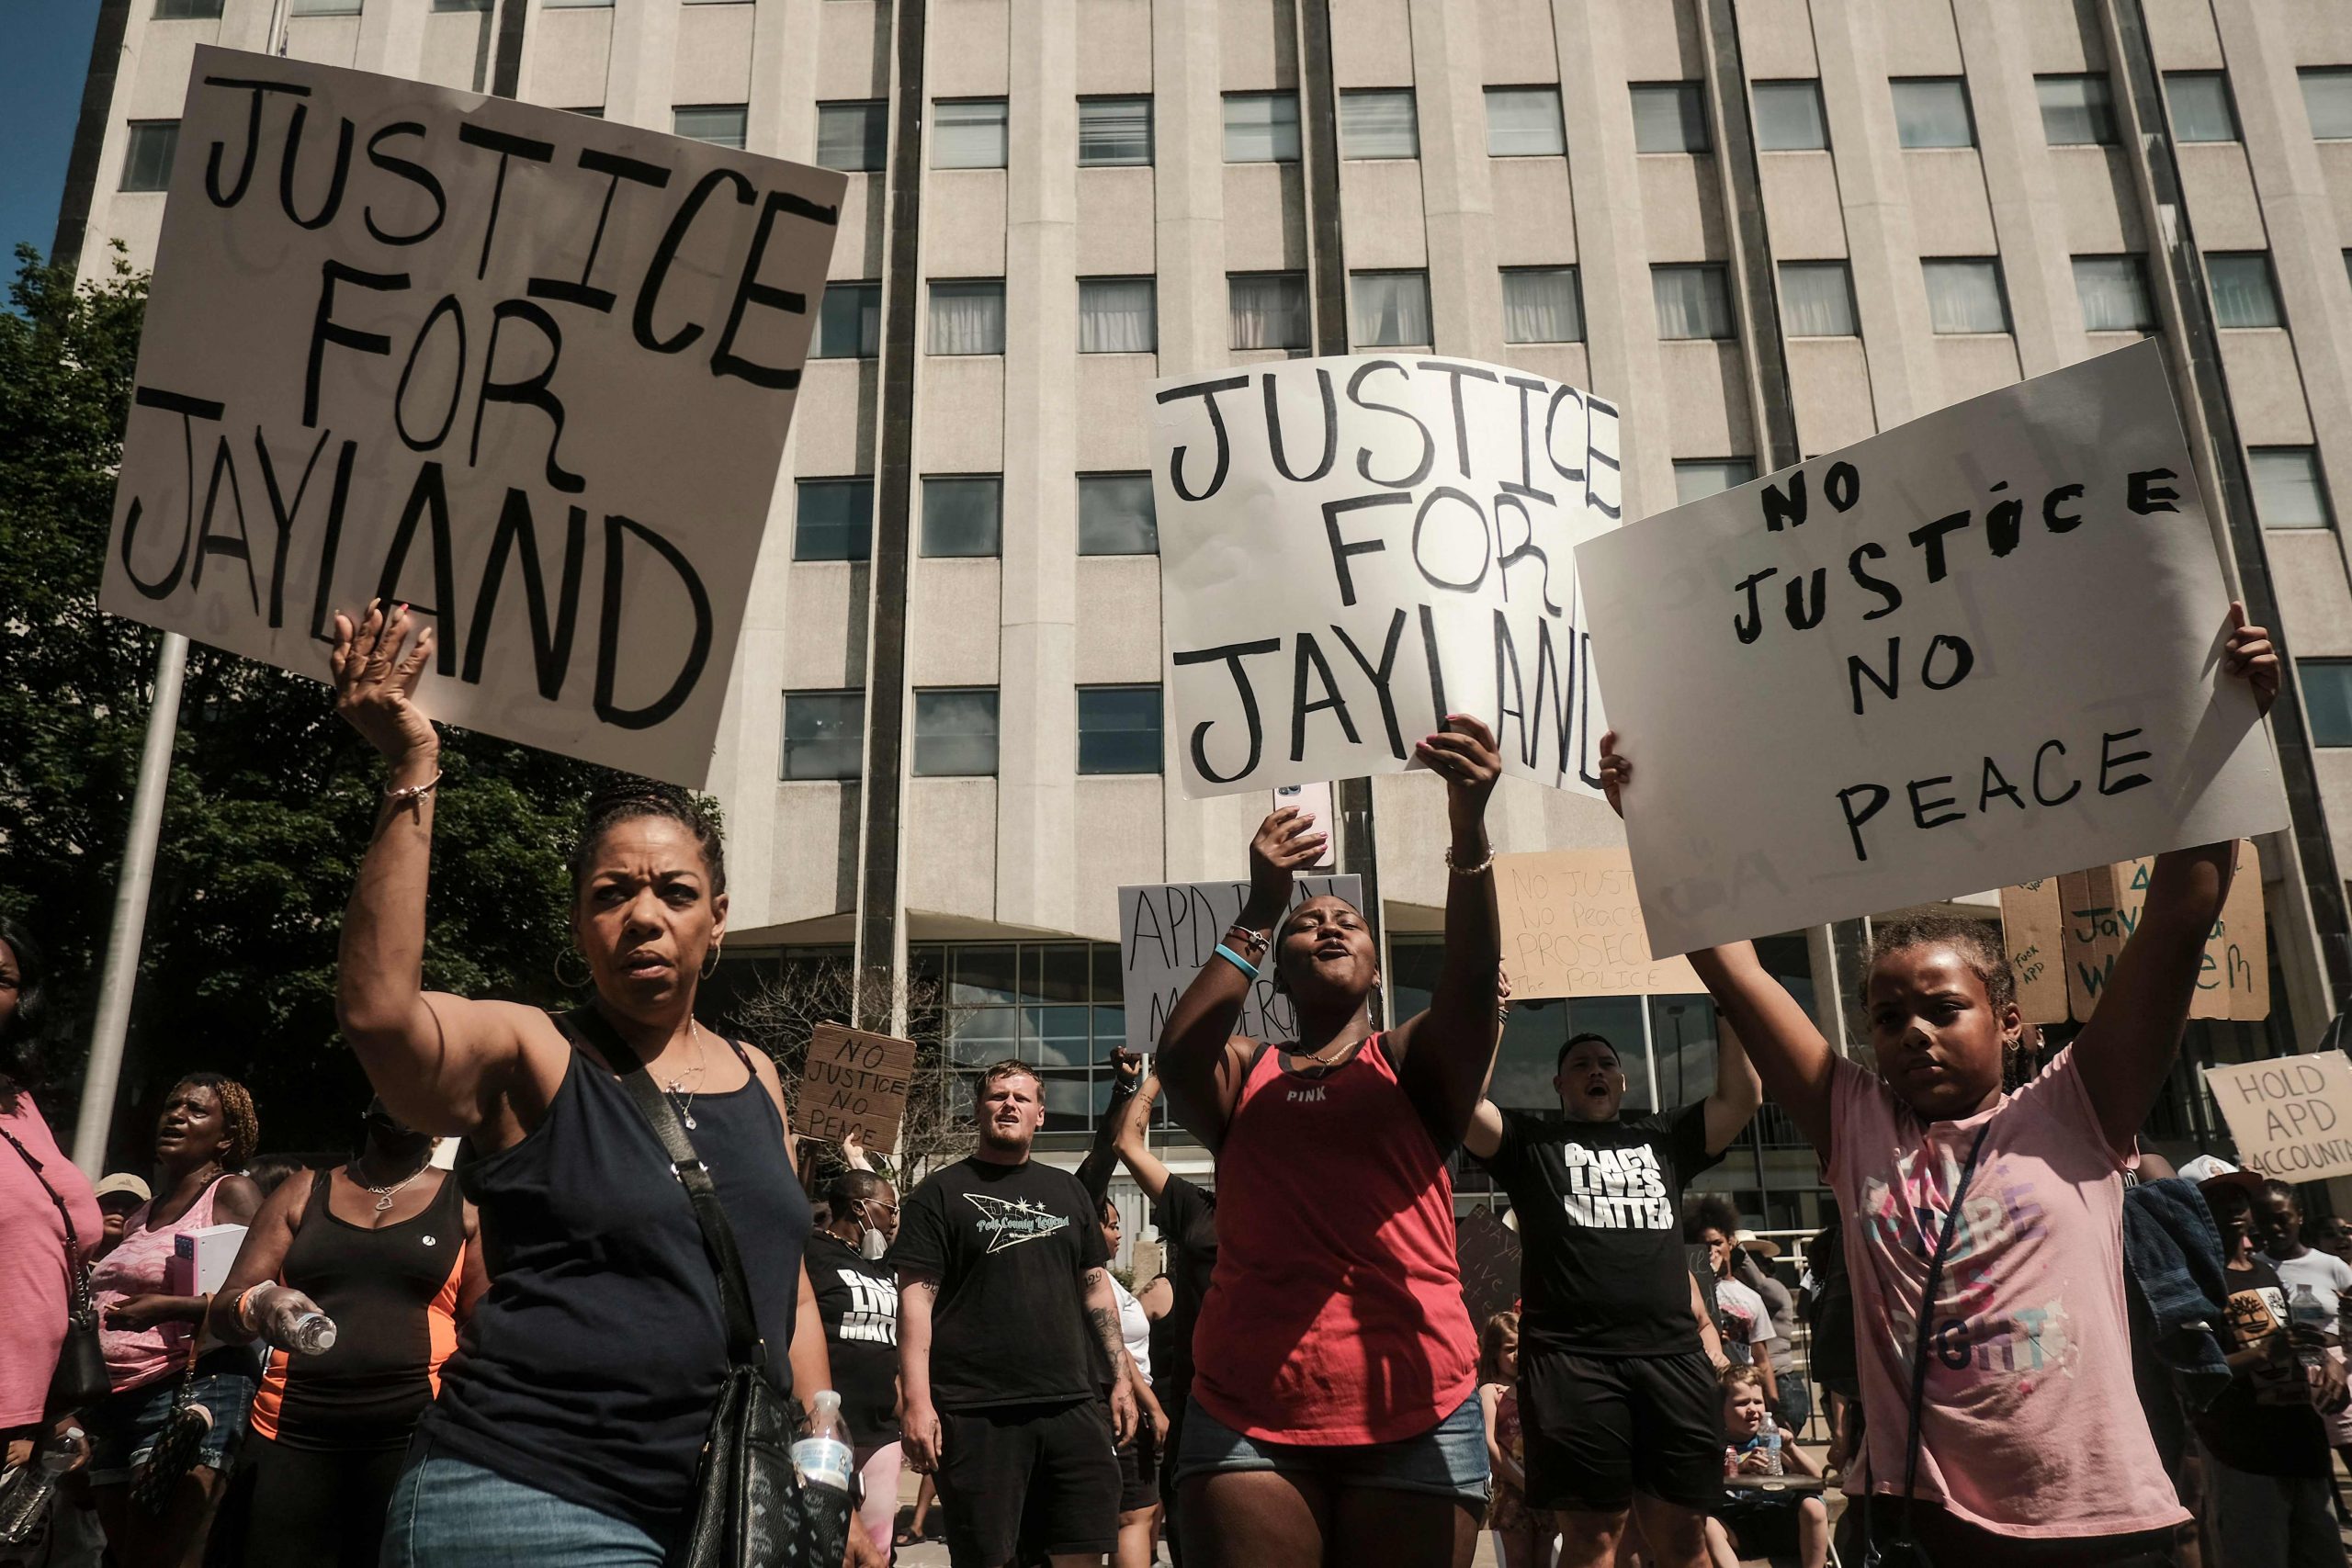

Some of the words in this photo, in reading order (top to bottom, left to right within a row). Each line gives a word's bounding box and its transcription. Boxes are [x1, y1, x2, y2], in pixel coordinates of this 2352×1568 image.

[204, 76, 836, 389] JUSTICE
[302, 259, 586, 493] FOR
[1156, 360, 1621, 519] JUSTICE
[1761, 461, 1860, 532] NO
[121, 386, 713, 730] JAYLAND
[1321, 487, 1563, 618] FOR
[1848, 634, 1973, 716] NO
[1837, 728, 2153, 861] PEACE
[1512, 869, 1549, 901] NO
[1562, 869, 1634, 897] JUST
[1129, 886, 1217, 971] APD
[1512, 975, 1544, 994] The
[1566, 967, 1661, 992] POLICE
[2023, 962, 2044, 985] APD
[834, 1039, 884, 1068] NO
[808, 1060, 907, 1095] JUSTICE
[1286, 1086, 1327, 1102] PINK
[2234, 1065, 2325, 1104] HOLD
[829, 1090, 868, 1114] NO
[2267, 1100, 2335, 1141] APD
[809, 1109, 876, 1146] PEACE
[1564, 1143, 1660, 1173] BLACK
[1569, 1166, 1666, 1198] LIVES
[1564, 1194, 1674, 1229] MATTER
